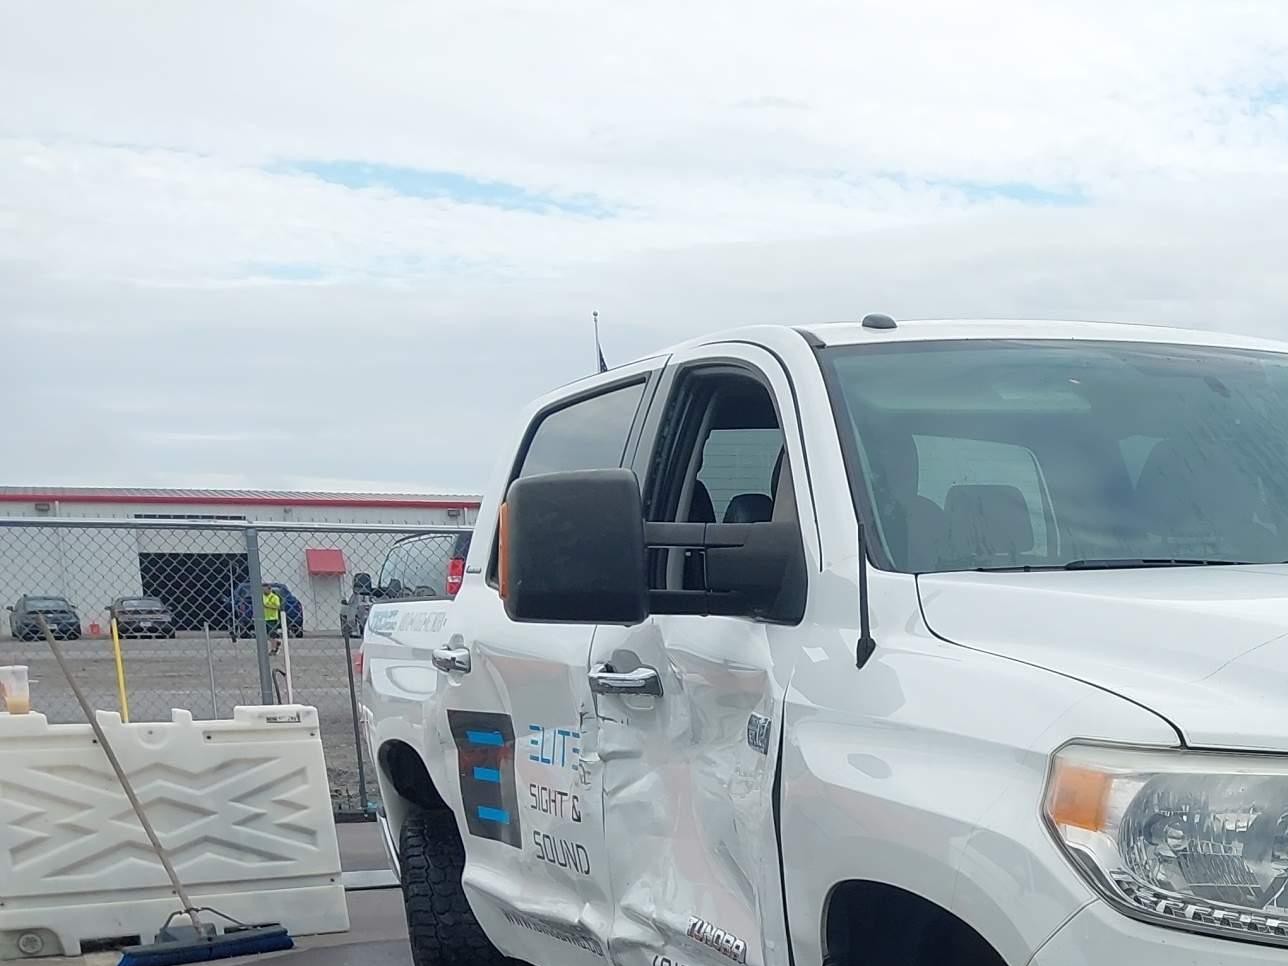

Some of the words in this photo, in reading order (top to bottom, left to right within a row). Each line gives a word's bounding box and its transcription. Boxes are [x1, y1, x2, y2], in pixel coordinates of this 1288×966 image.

[530, 784, 568, 818] SIGHT
[571, 795, 582, 823] &
[533, 830, 590, 875] SOUND
[687, 916, 747, 964] TUNDRA
